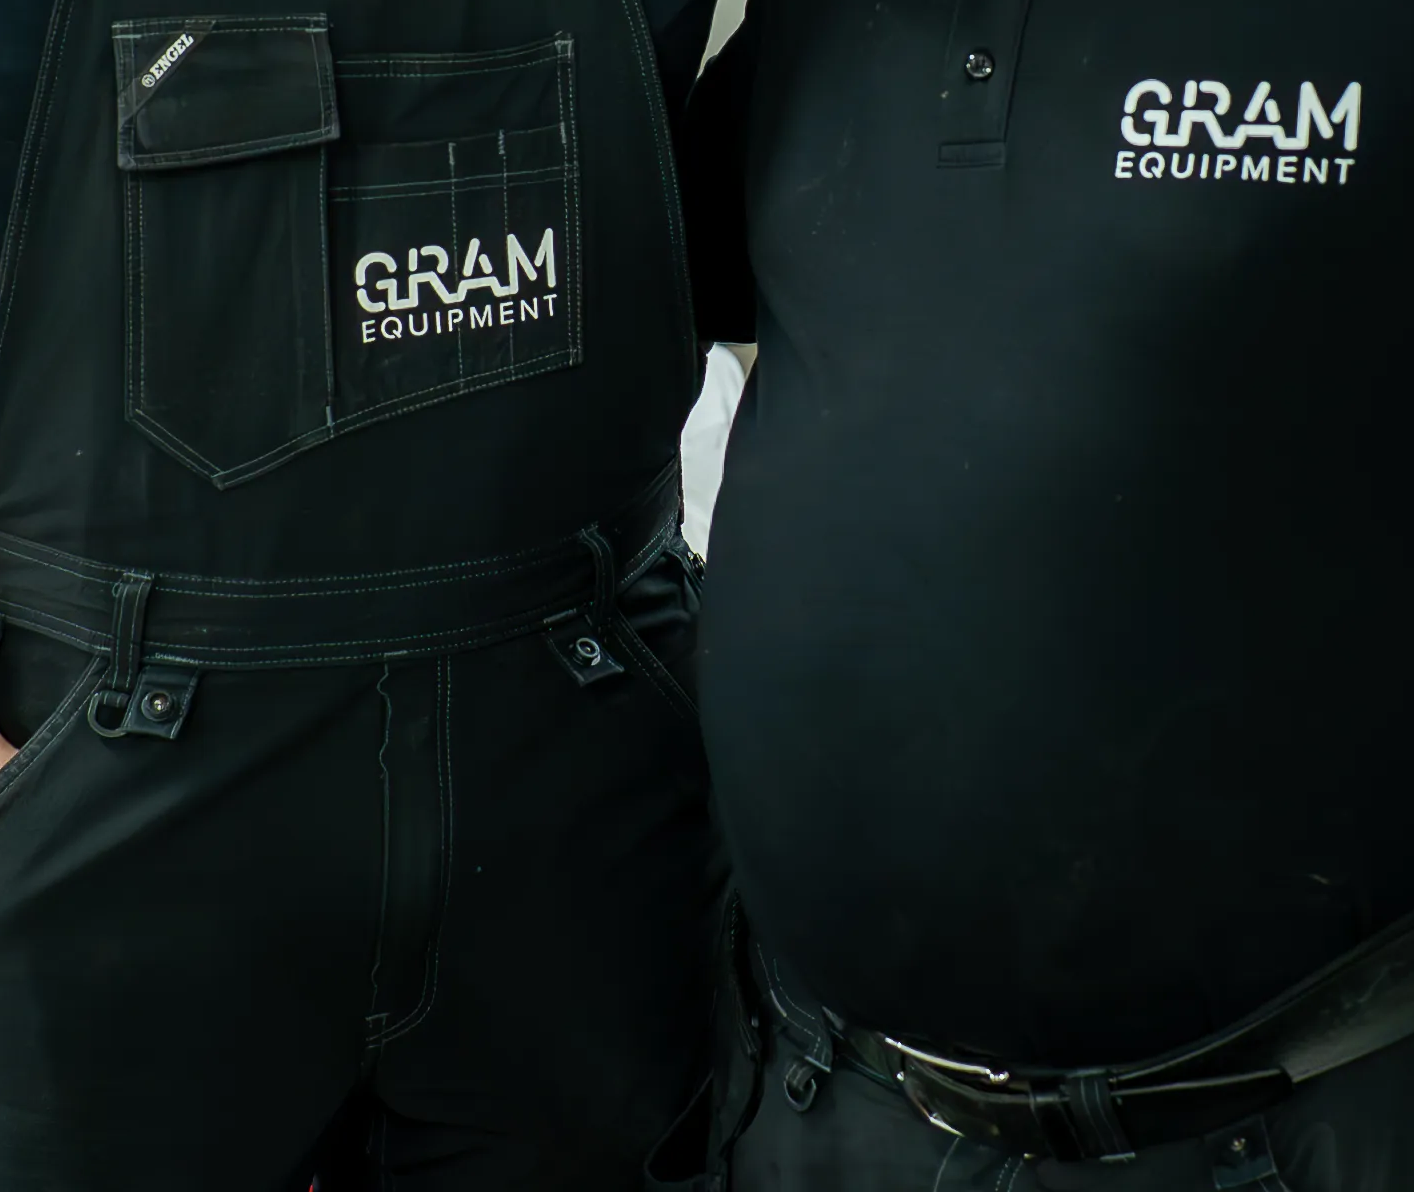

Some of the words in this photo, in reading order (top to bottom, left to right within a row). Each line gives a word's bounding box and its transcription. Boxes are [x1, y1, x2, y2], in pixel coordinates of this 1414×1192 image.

[149, 33, 194, 80] ENGEL
[1120, 78, 1362, 152] GRAM
[1114, 150, 1355, 185] EQUIPMENT
[355, 227, 557, 313] GRAM
[361, 294, 558, 344] EQUIPMENT
